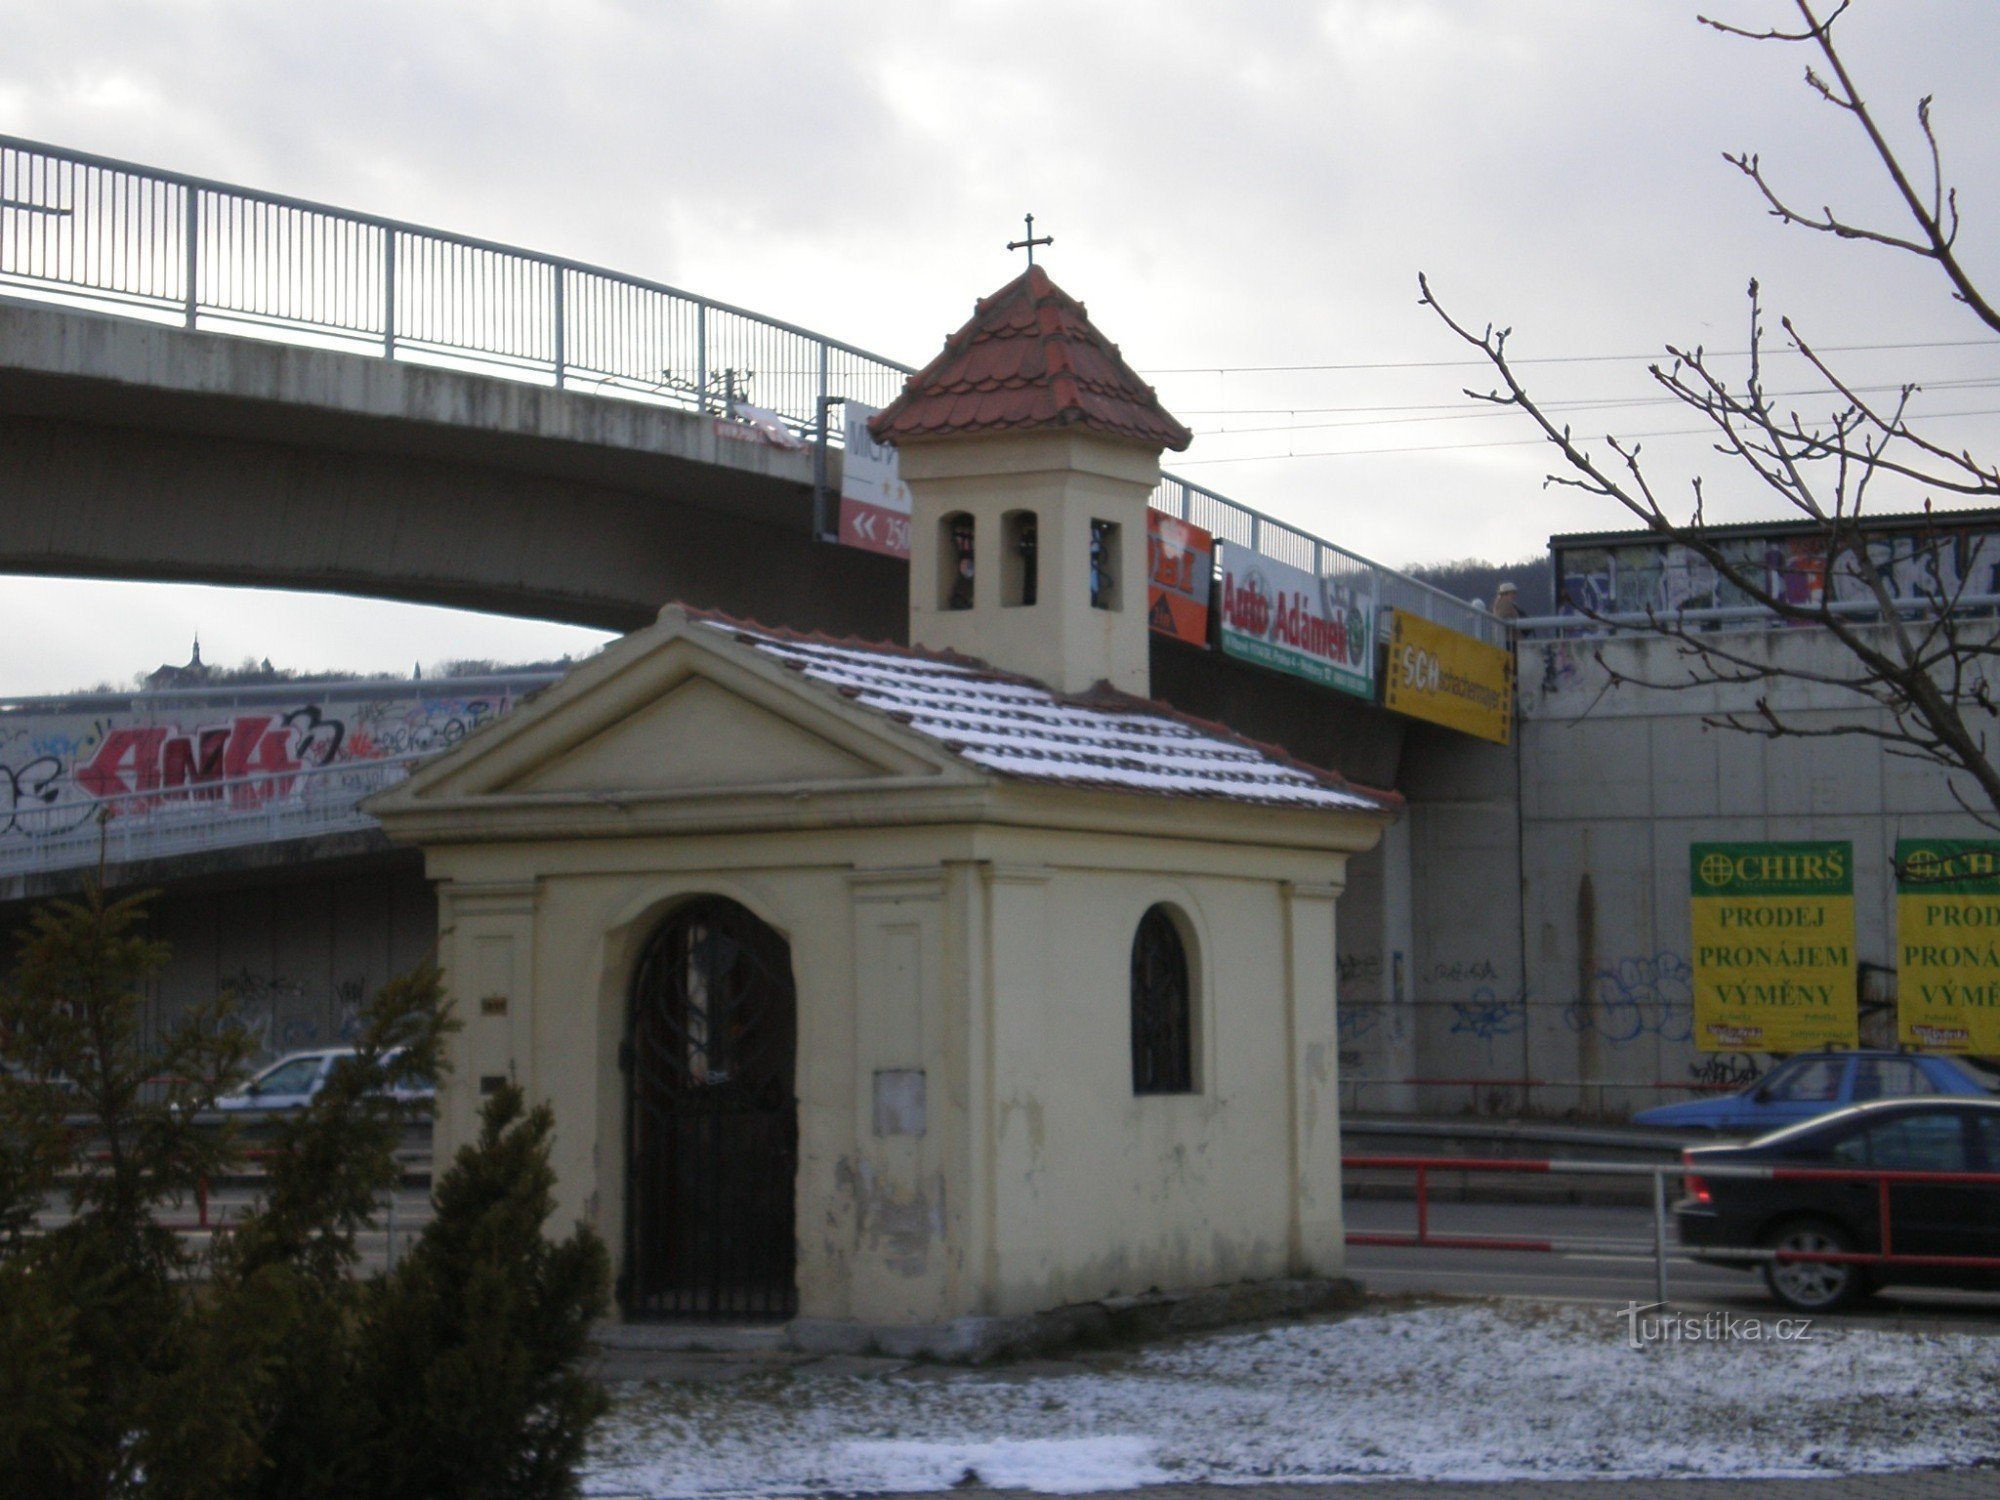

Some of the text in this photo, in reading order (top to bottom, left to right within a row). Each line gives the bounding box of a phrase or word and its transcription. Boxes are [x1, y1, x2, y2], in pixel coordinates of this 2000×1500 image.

[1224, 571, 1270, 635] Auto
[1273, 591, 1347, 664] Adámek
[1736, 849, 1845, 881] CHIRŠ
[1719, 906, 1825, 928] PRODEJ
[1699, 940, 1848, 968] PRONÁJEM
[1716, 979, 1834, 1006] VÝMĚNY
